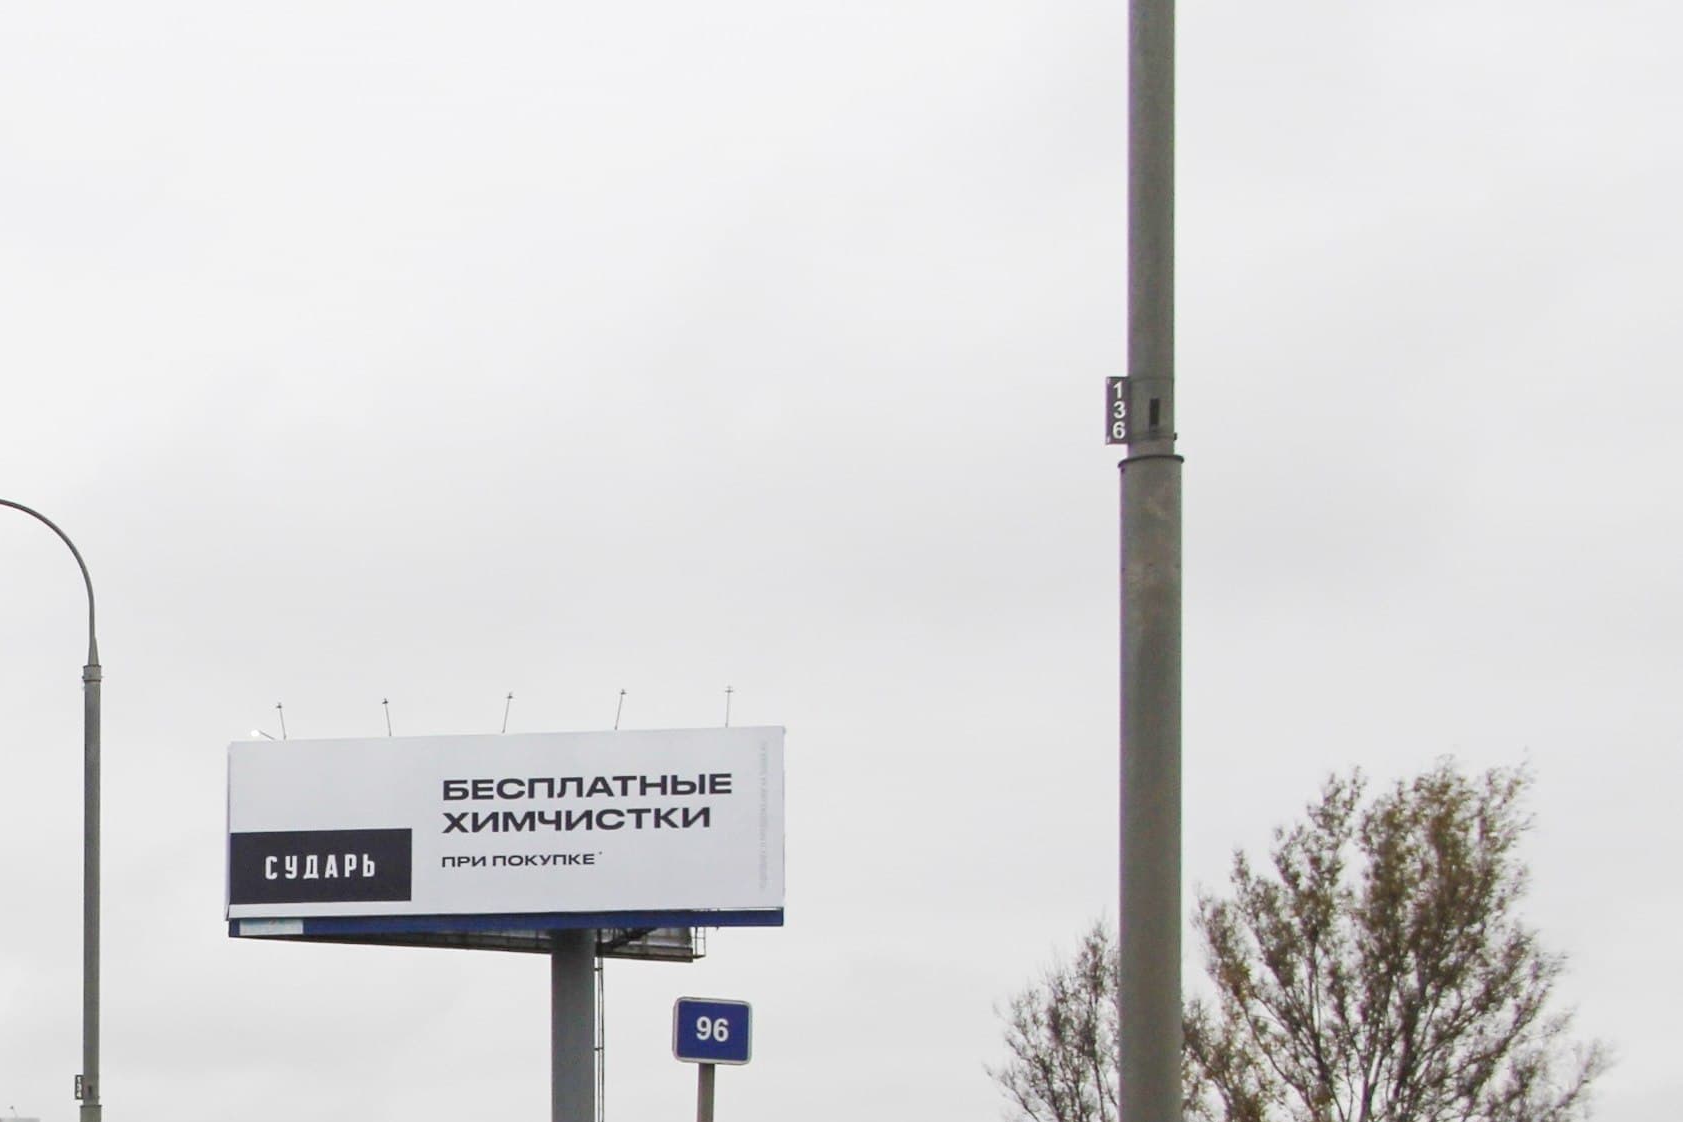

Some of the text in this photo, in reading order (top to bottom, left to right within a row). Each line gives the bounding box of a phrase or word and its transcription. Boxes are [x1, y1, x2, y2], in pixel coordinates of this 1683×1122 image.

[1112, 380, 1126, 440] 136
[442, 773, 733, 801] БЕСПЛАТНЫЕ
[441, 806, 711, 834] ХИМЧИСТКИ
[264, 853, 376, 880] СУДАРЬ
[441, 855, 487, 868] ПРИ
[696, 1015, 730, 1043] 96
